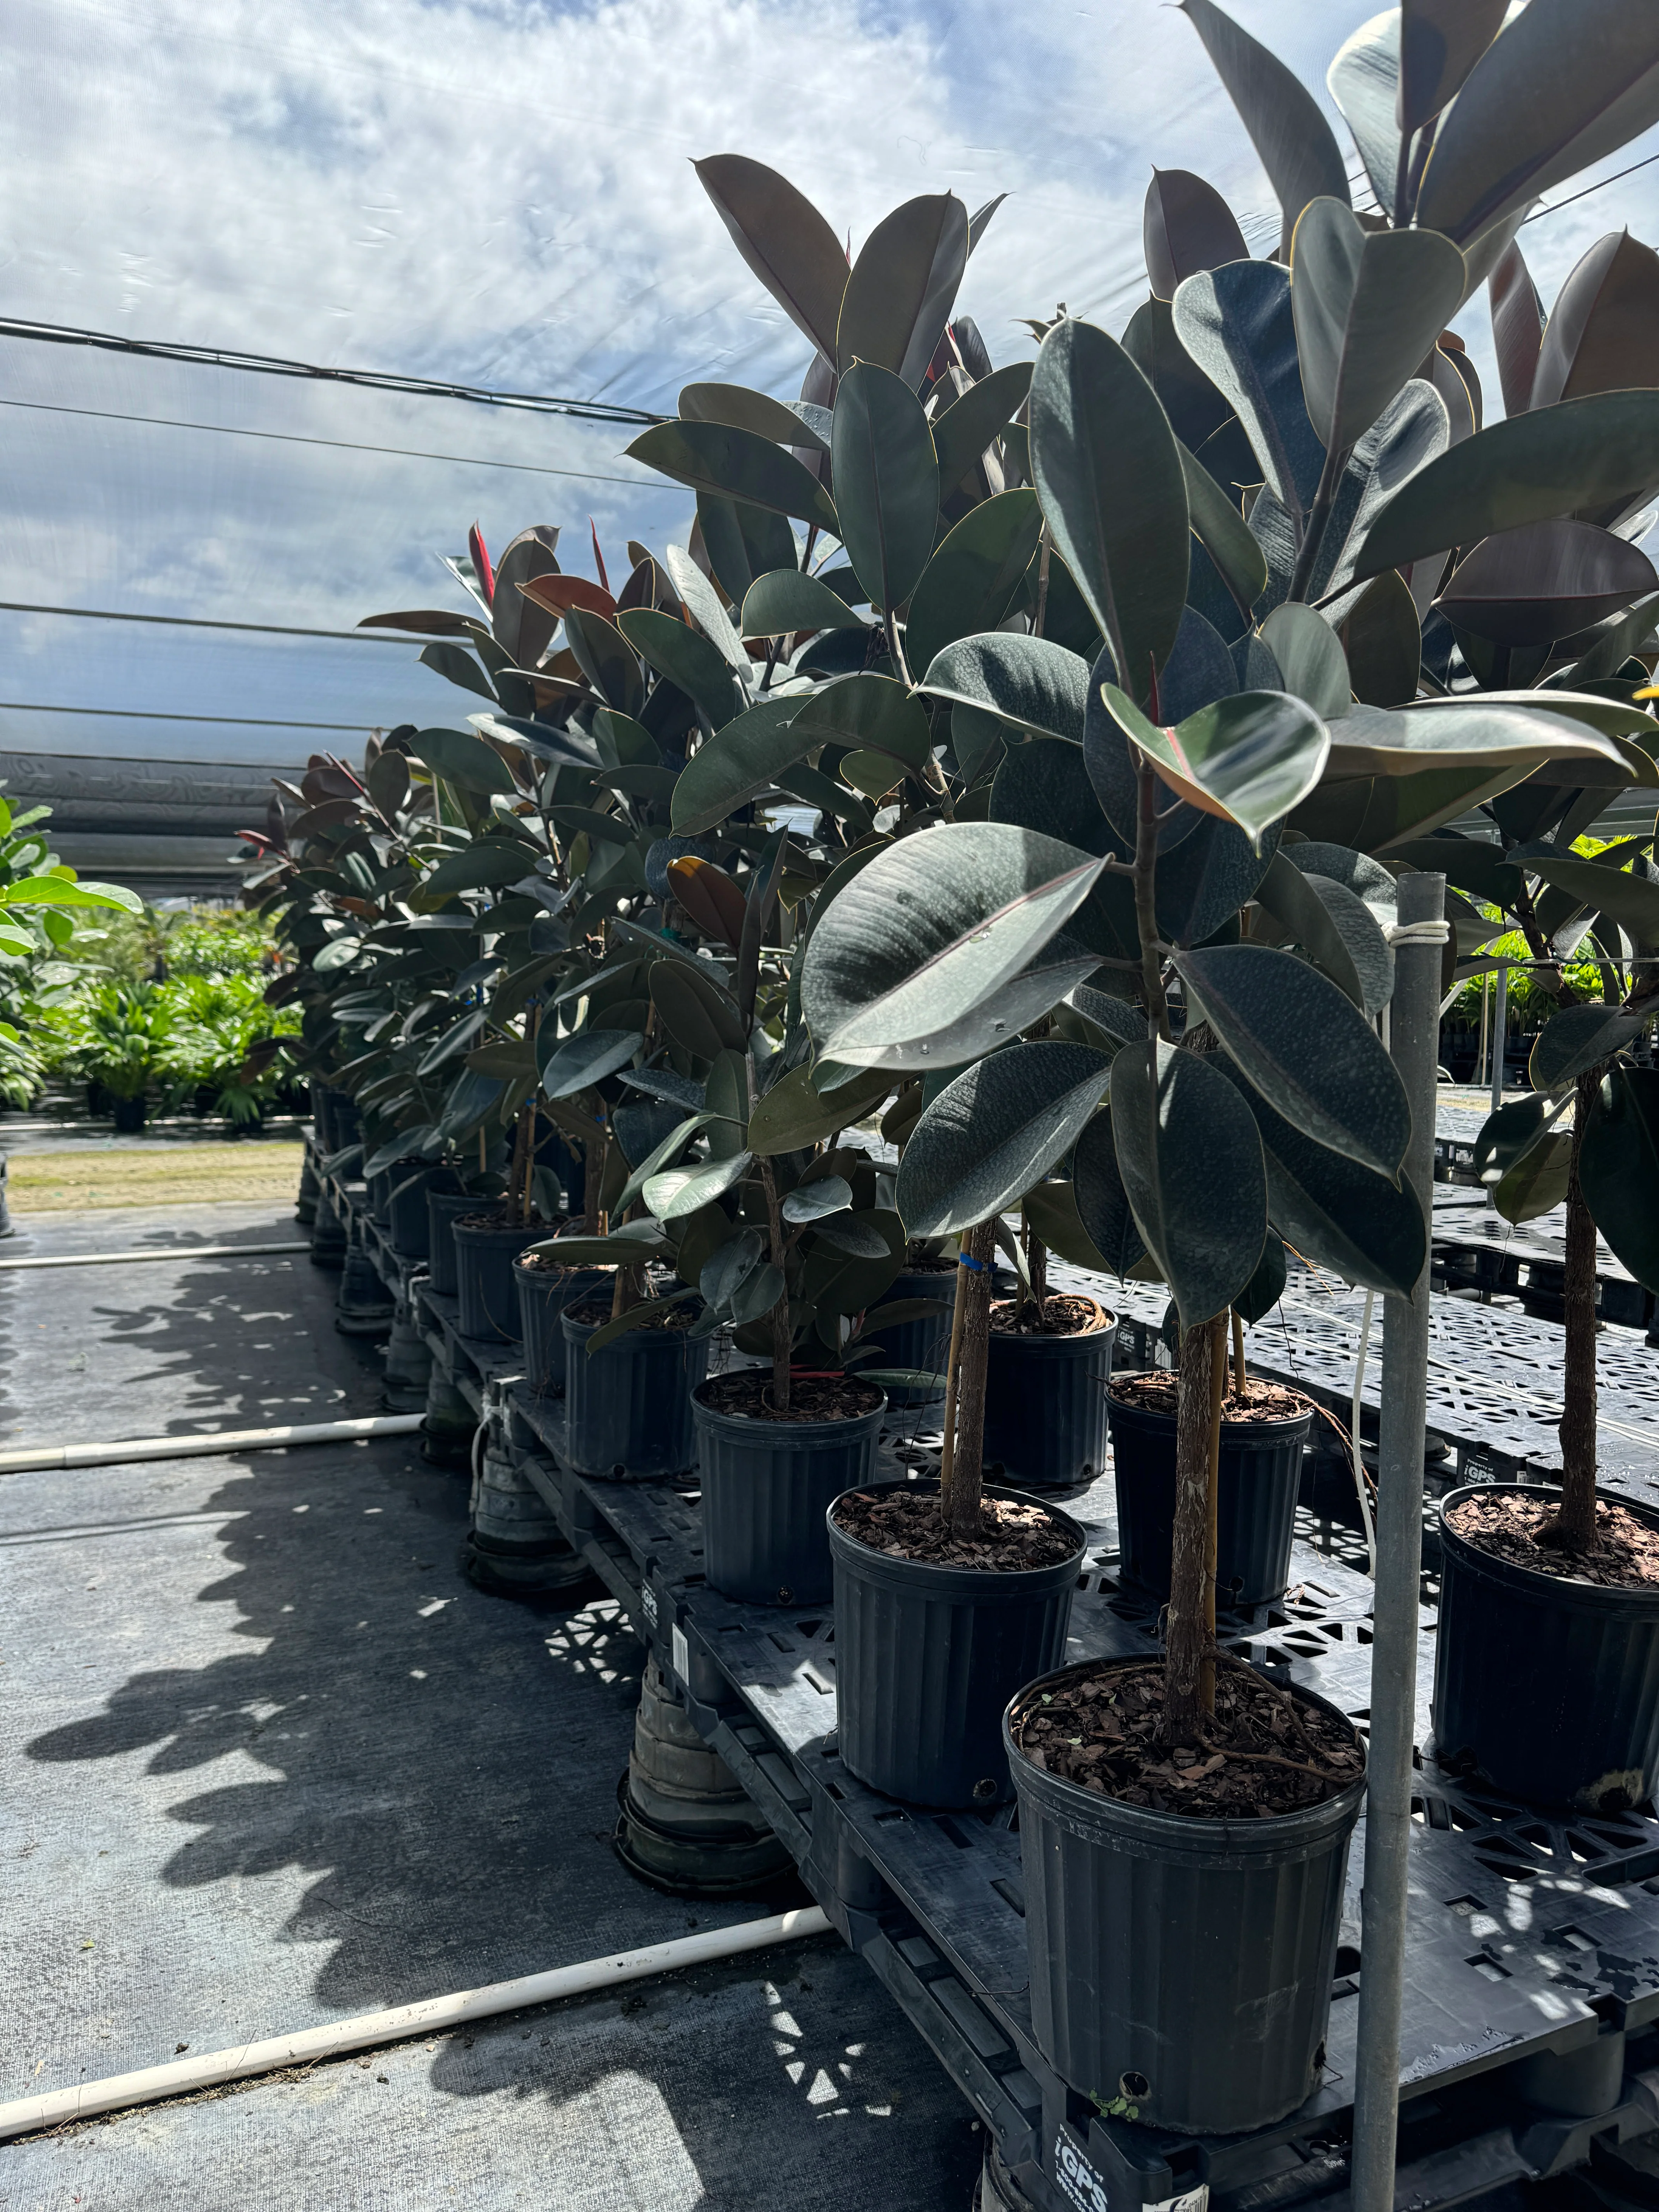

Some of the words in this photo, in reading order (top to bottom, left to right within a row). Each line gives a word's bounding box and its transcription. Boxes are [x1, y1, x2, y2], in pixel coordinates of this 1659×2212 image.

[1464, 1465, 1496, 1484] iGPS
[1055, 2136, 1108, 2212] iGPS
[1060, 2123, 1093, 2170] Property
[1094, 2170, 1104, 2183] of
